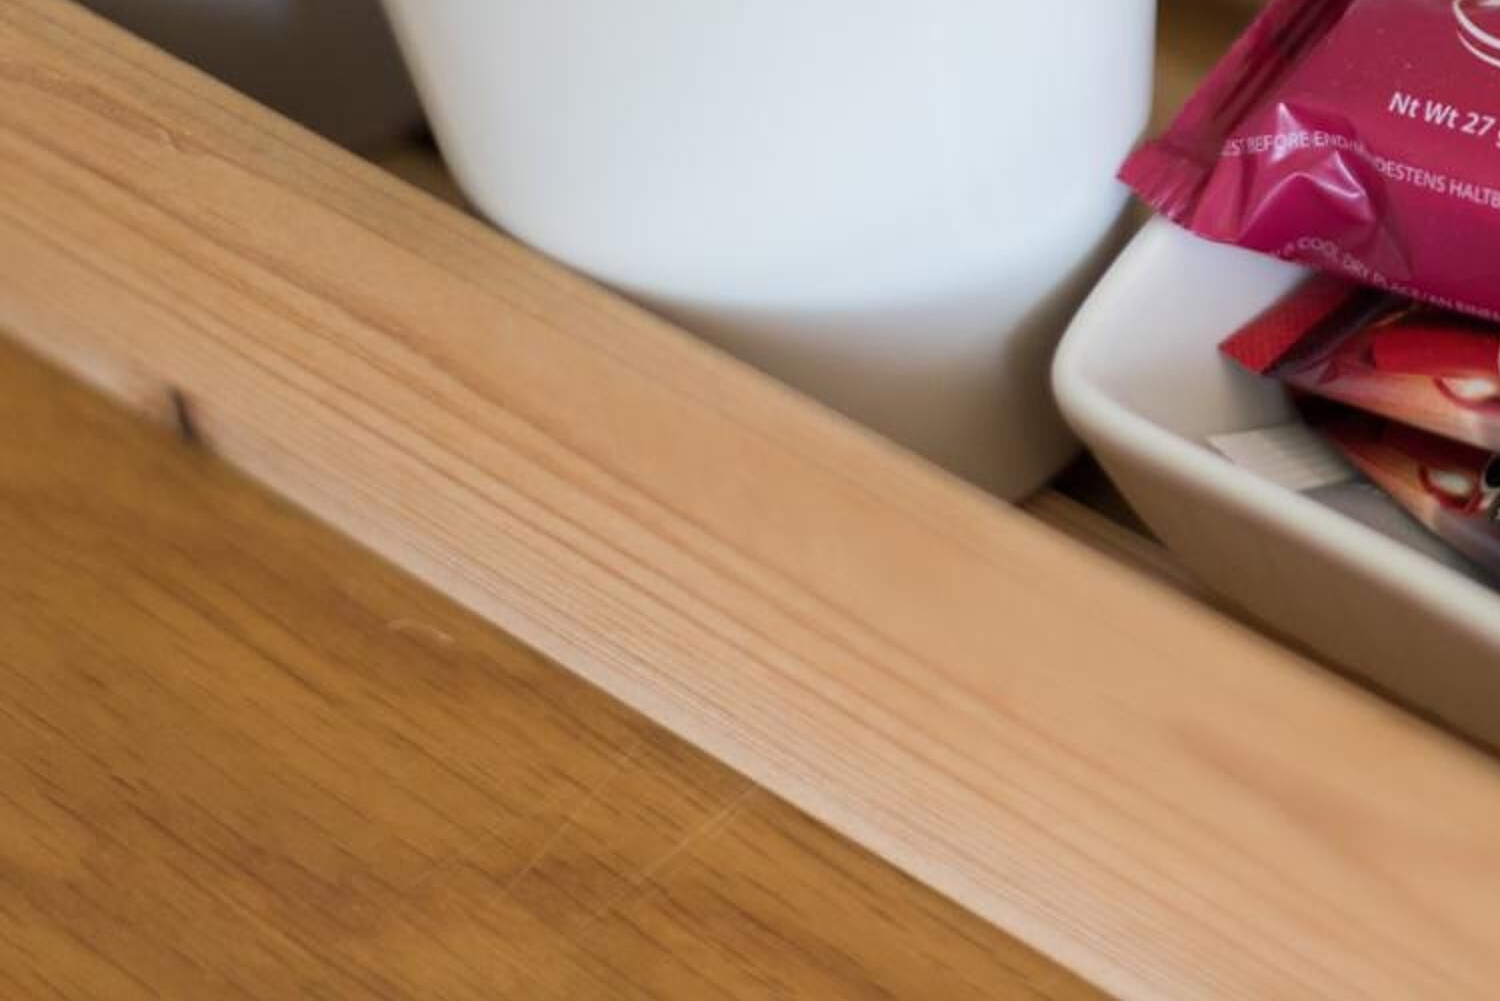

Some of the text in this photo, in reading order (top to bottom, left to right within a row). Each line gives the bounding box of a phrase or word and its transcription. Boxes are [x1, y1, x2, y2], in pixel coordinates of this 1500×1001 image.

[1388, 91, 1418, 119] Nt
[1423, 100, 1461, 130] Wt
[1460, 111, 1496, 137] 27
